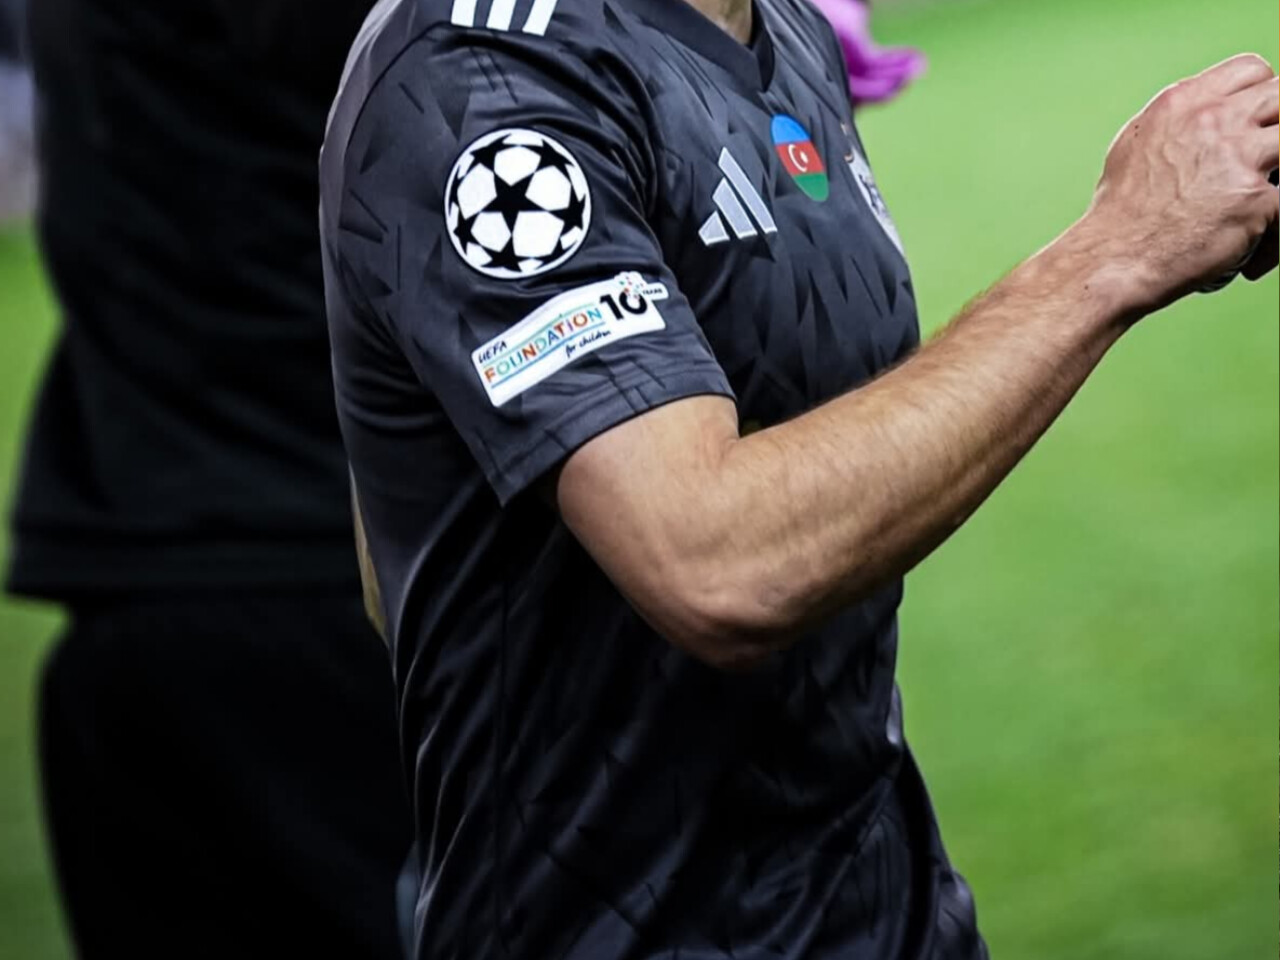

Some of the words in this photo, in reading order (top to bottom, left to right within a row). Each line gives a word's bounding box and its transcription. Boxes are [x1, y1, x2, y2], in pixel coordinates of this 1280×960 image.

[599, 290, 648, 321] 10
[478, 340, 508, 364] UEFA
[484, 307, 603, 383] FOUNDATION
